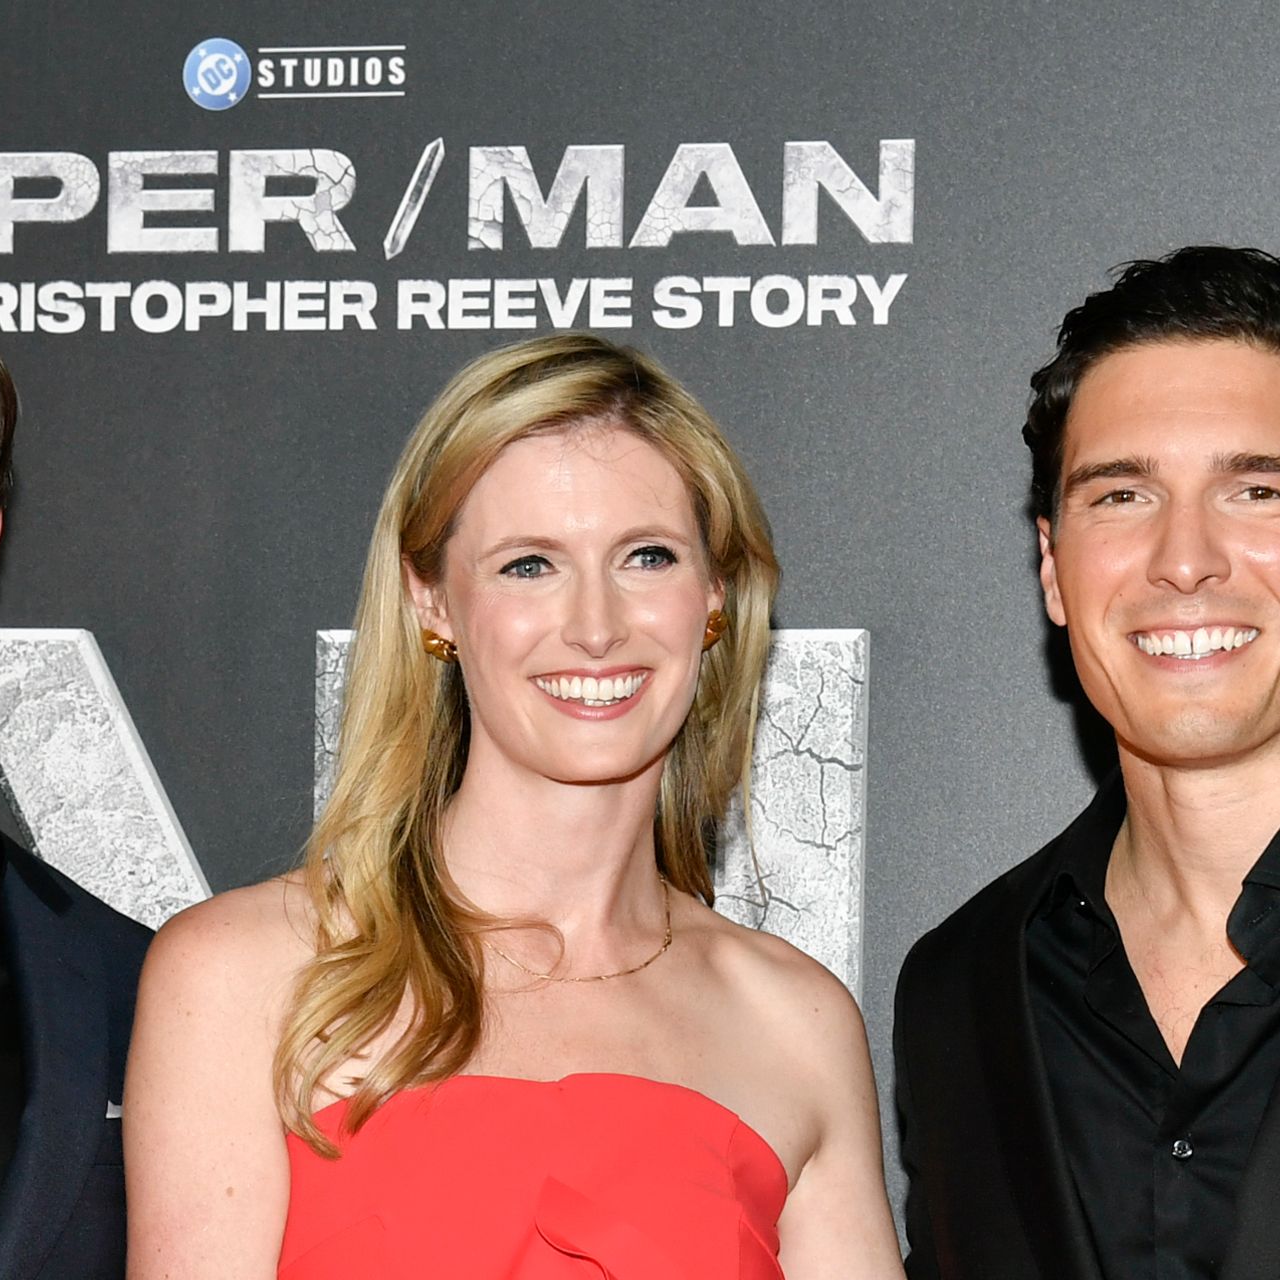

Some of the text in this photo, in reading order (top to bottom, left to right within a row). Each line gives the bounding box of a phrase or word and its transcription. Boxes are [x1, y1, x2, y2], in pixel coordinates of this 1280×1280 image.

[257, 56, 406, 88] STUDIOS
[396, 277, 633, 330] REEVE
[652, 273, 908, 329] STORY
